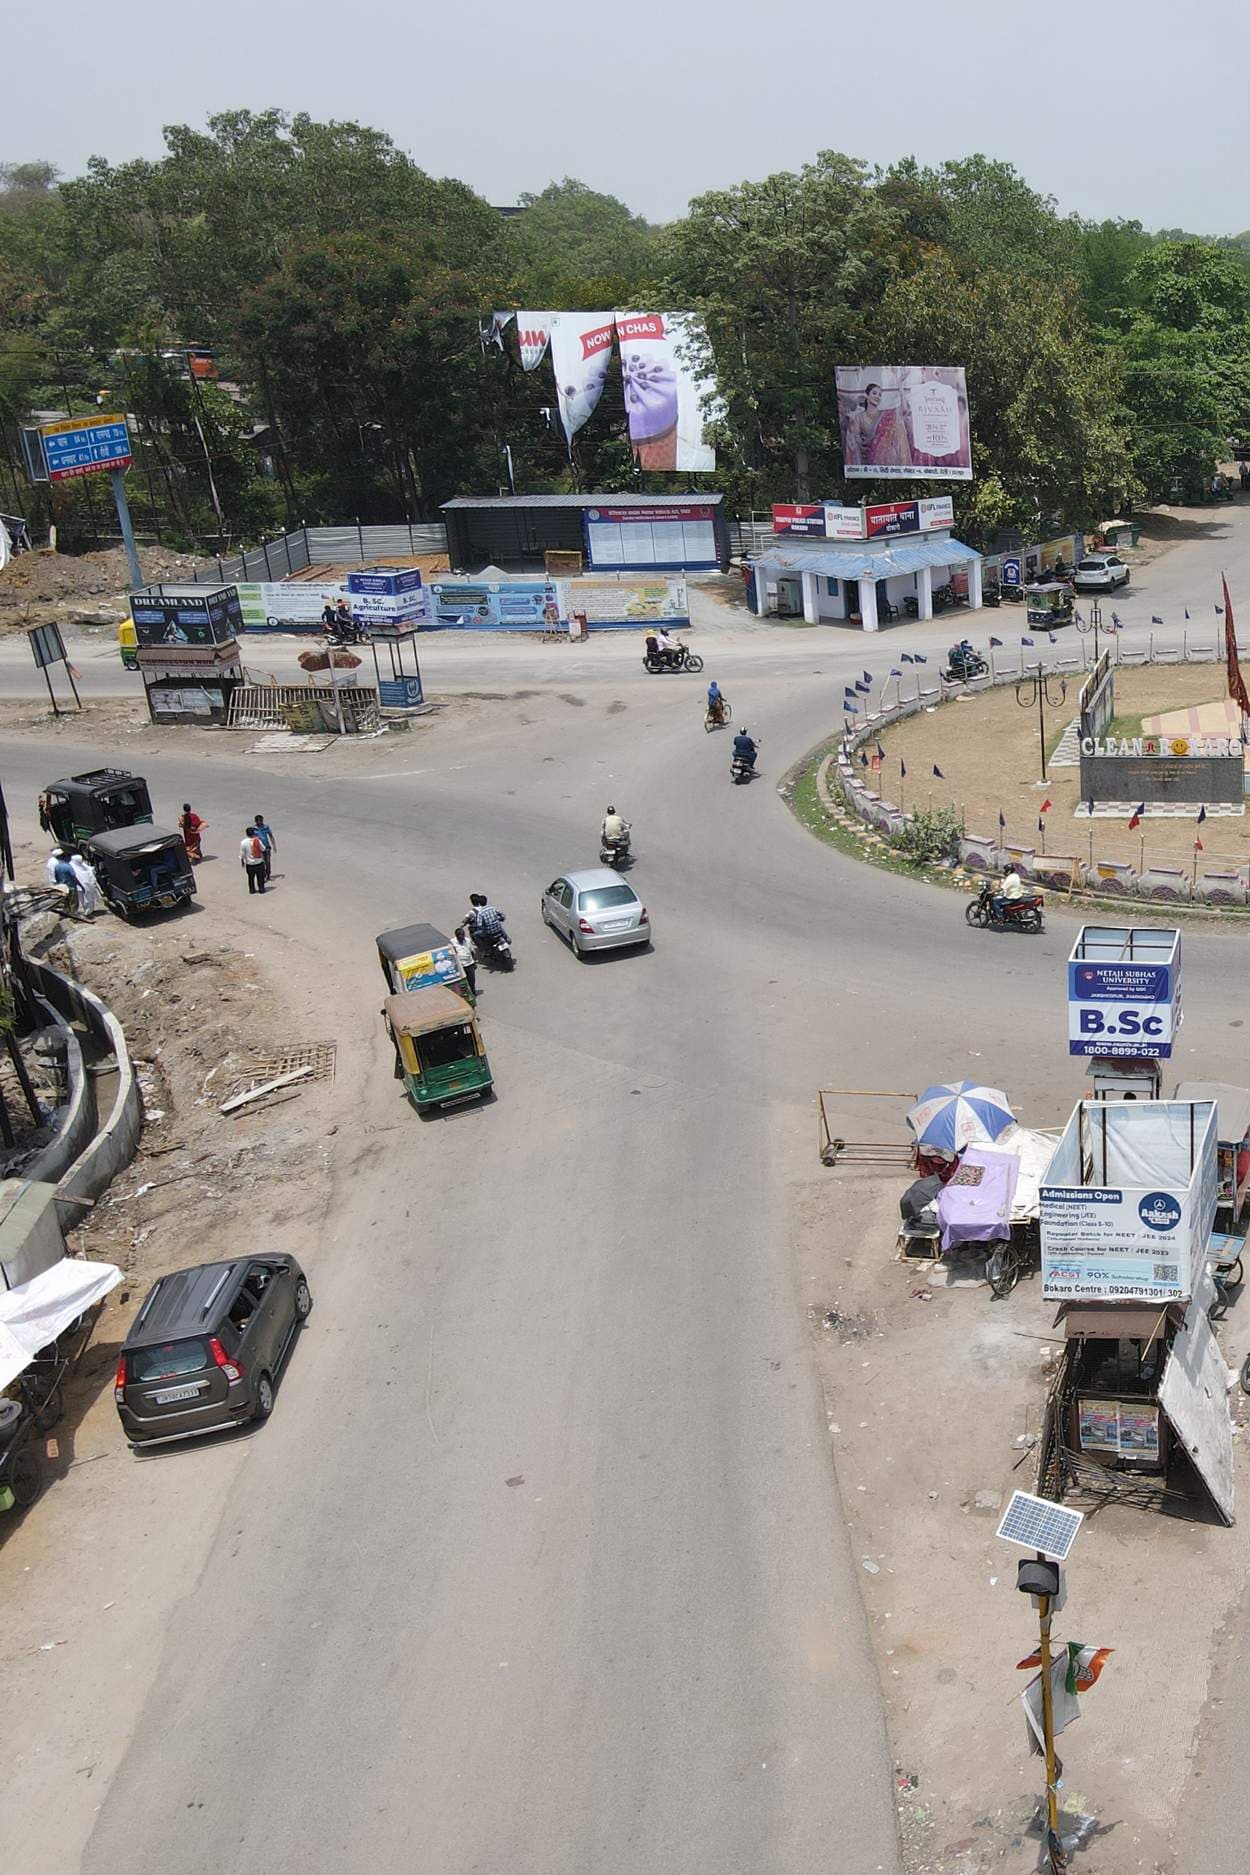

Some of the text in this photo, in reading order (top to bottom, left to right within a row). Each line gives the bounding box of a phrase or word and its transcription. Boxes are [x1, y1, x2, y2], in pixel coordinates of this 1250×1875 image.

[587, 330, 611, 349] NOW
[626, 322, 657, 335] CHAS
[134, 598, 204, 607] DREAMLAND
[353, 604, 396, 613] Agriculture
[1082, 737, 1144, 756] CLEAN
[1102, 977, 1150, 985] UNIVERSITY
[1080, 1009, 1163, 1036] B.Sc
[1084, 1046, 1160, 1056] 1800-8899-022
[1042, 1190, 1120, 1201] Admissions Open
[1141, 1208, 1179, 1219] Aakash
[1087, 1271, 1109, 1279] 90%
[1044, 1284, 1073, 1293] Bokaro
[1075, 1284, 1102, 1293] Centre
